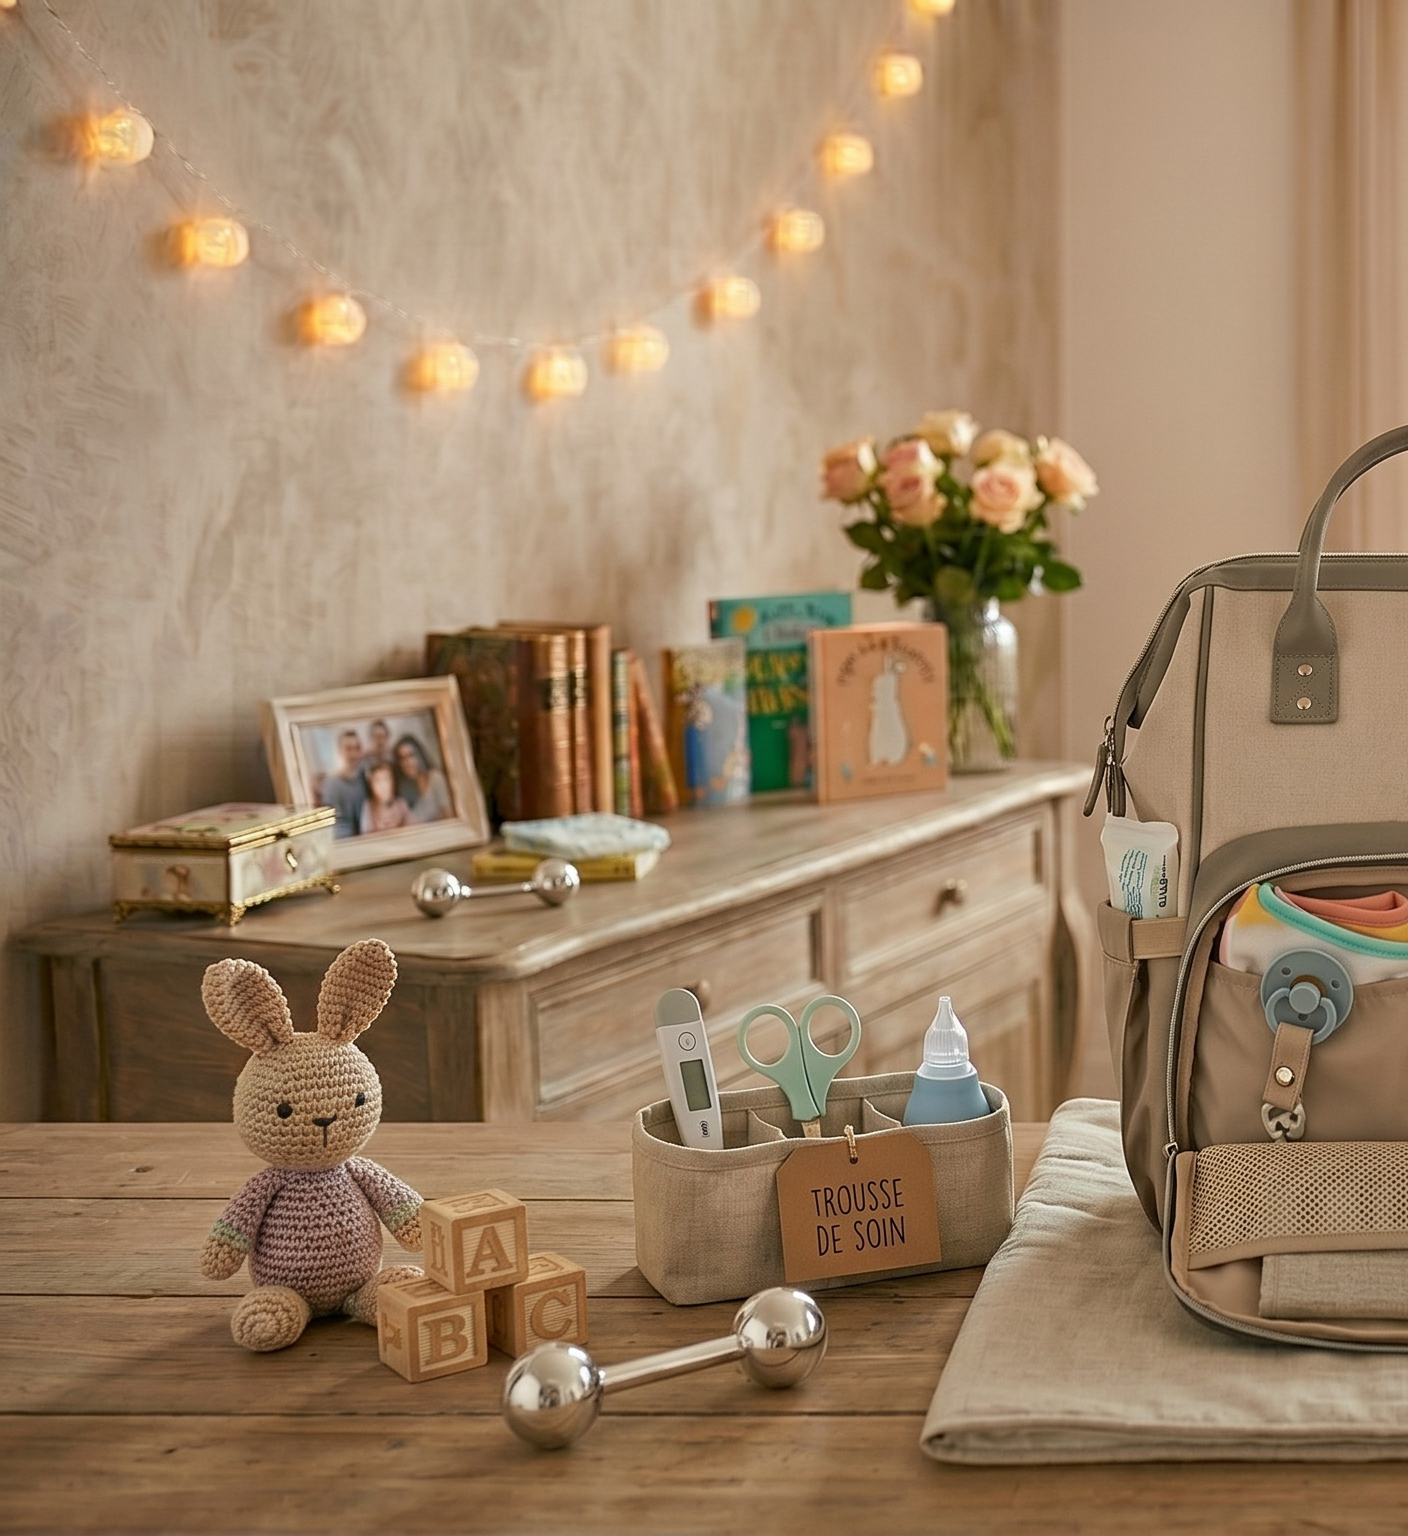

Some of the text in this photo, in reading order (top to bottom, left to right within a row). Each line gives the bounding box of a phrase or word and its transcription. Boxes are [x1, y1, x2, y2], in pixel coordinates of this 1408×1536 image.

[811, 1178, 905, 1218] TROUSSE
[465, 1225, 514, 1279] A
[817, 1216, 905, 1257] DE SOIN
[421, 1313, 469, 1367] B
[530, 1289, 573, 1340] C
